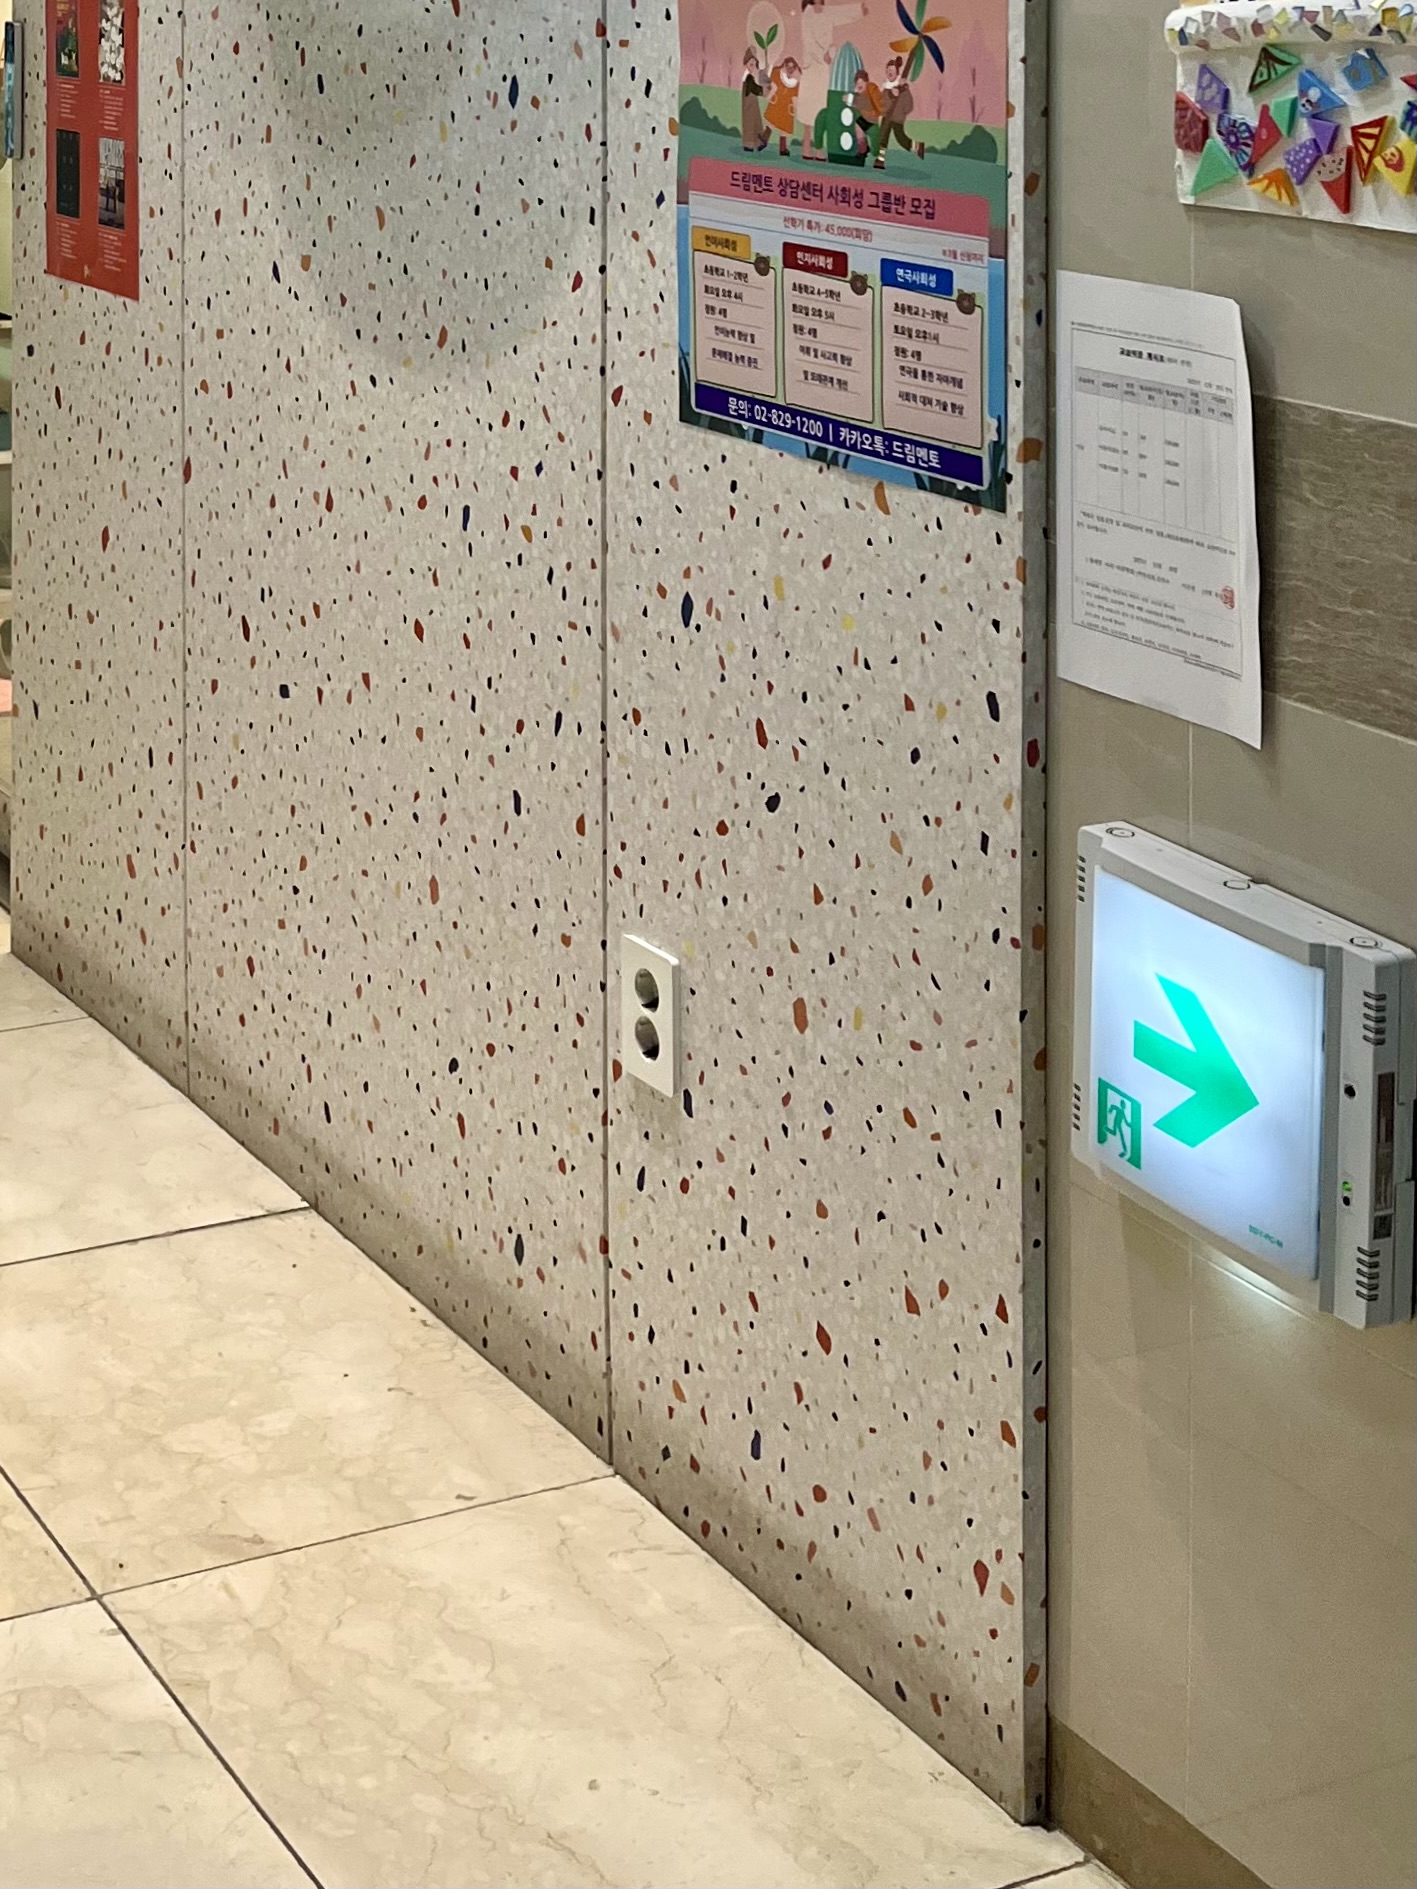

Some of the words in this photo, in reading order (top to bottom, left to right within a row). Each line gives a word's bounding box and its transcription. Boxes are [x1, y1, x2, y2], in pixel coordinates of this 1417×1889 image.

[730, 171, 774, 193] 드림멘토
[777, 177, 823, 203] 상담센터
[827, 185, 864, 209] 사회성
[868, 191, 906, 215] 그룹반
[909, 197, 936, 220] 모집
[728, 396, 752, 418] 문의:
[754, 404, 823, 437] 02-829-1200
[892, 440, 941, 469] 드림멘토
